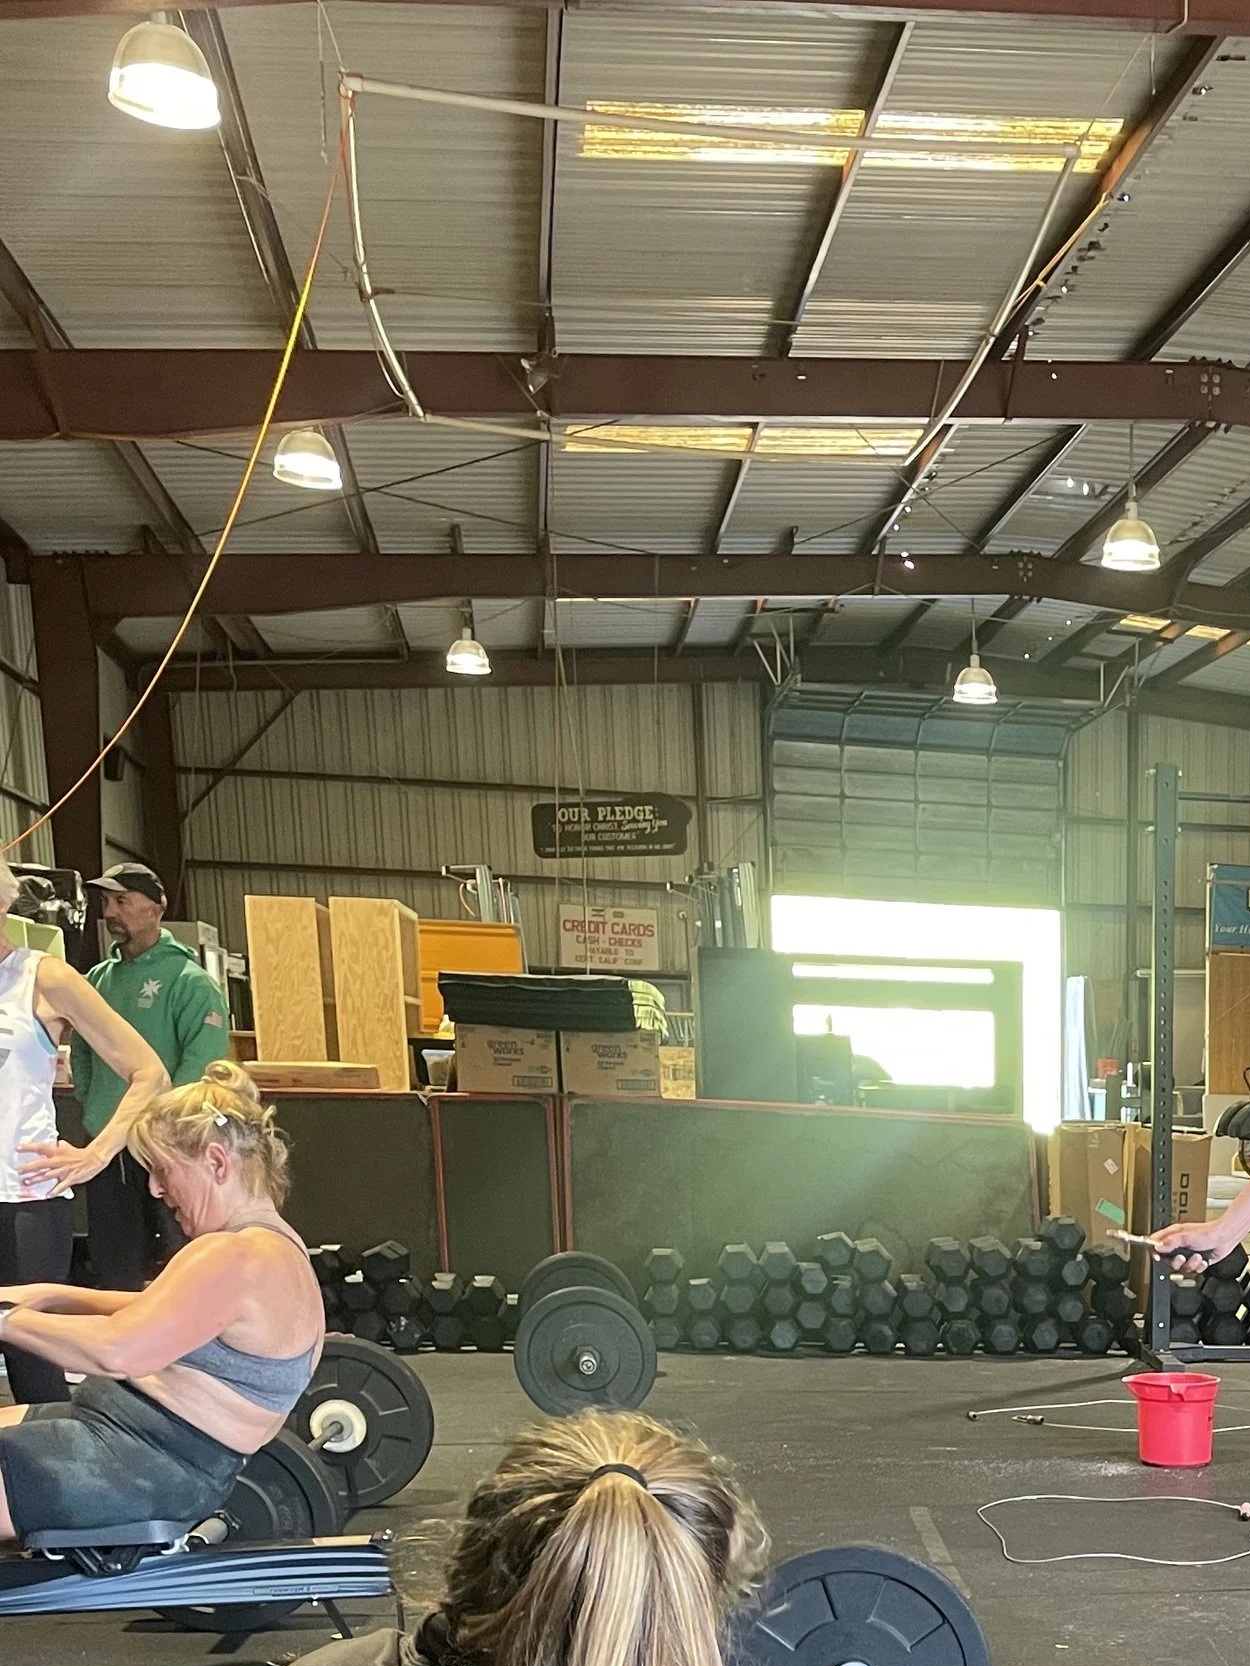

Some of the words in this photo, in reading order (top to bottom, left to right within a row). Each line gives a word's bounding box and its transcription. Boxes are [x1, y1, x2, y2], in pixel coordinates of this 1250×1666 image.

[558, 807, 591, 822] OUR
[597, 805, 660, 821] PLEDGE:
[562, 919, 608, 934] CREDIT
[611, 922, 655, 937] CARDS
[1214, 923, 1237, 933] Your
[576, 934, 600, 945] CASH
[608, 936, 643, 948] CHECKS
